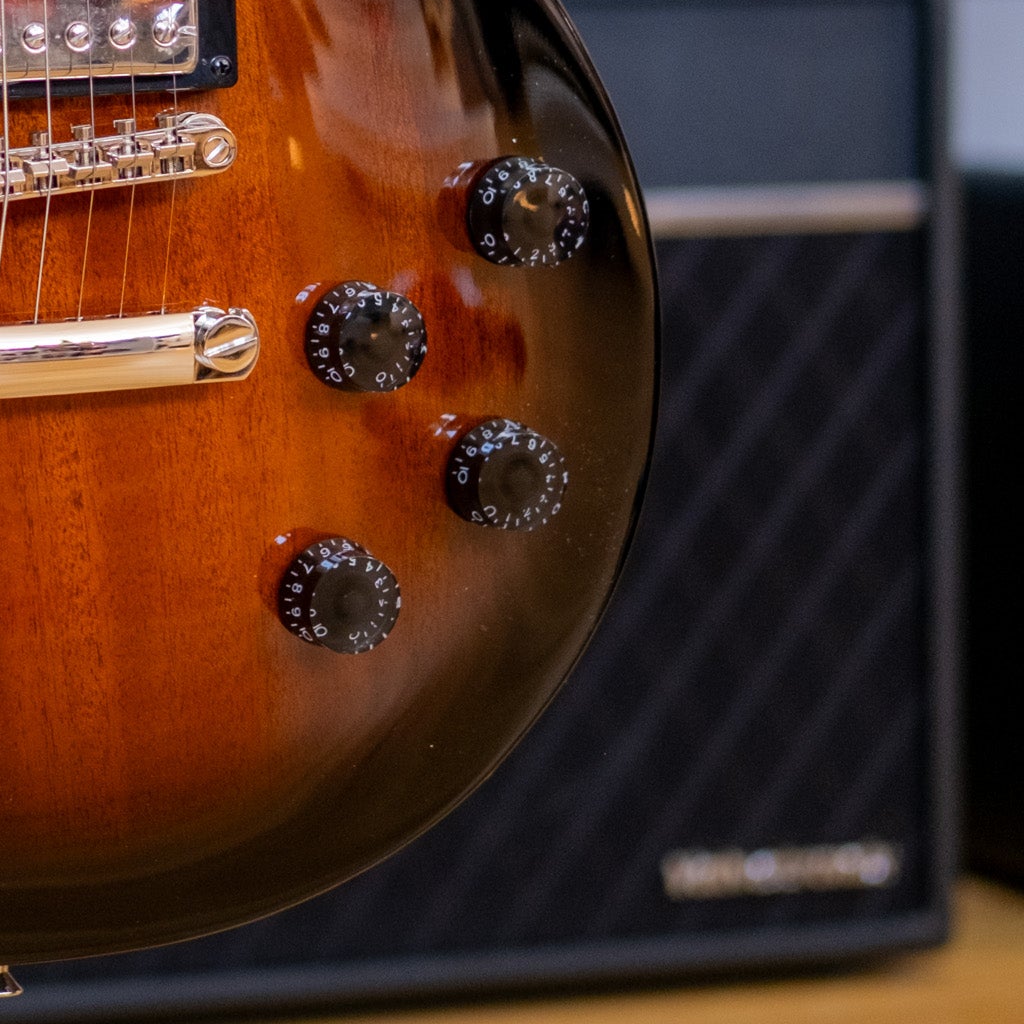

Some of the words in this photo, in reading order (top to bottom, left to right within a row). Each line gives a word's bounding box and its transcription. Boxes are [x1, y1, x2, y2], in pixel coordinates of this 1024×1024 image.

[318, 323, 330, 334] 8
[328, 303, 340, 315] 7
[291, 582, 303, 594] 8
[303, 563, 314, 575] 7
